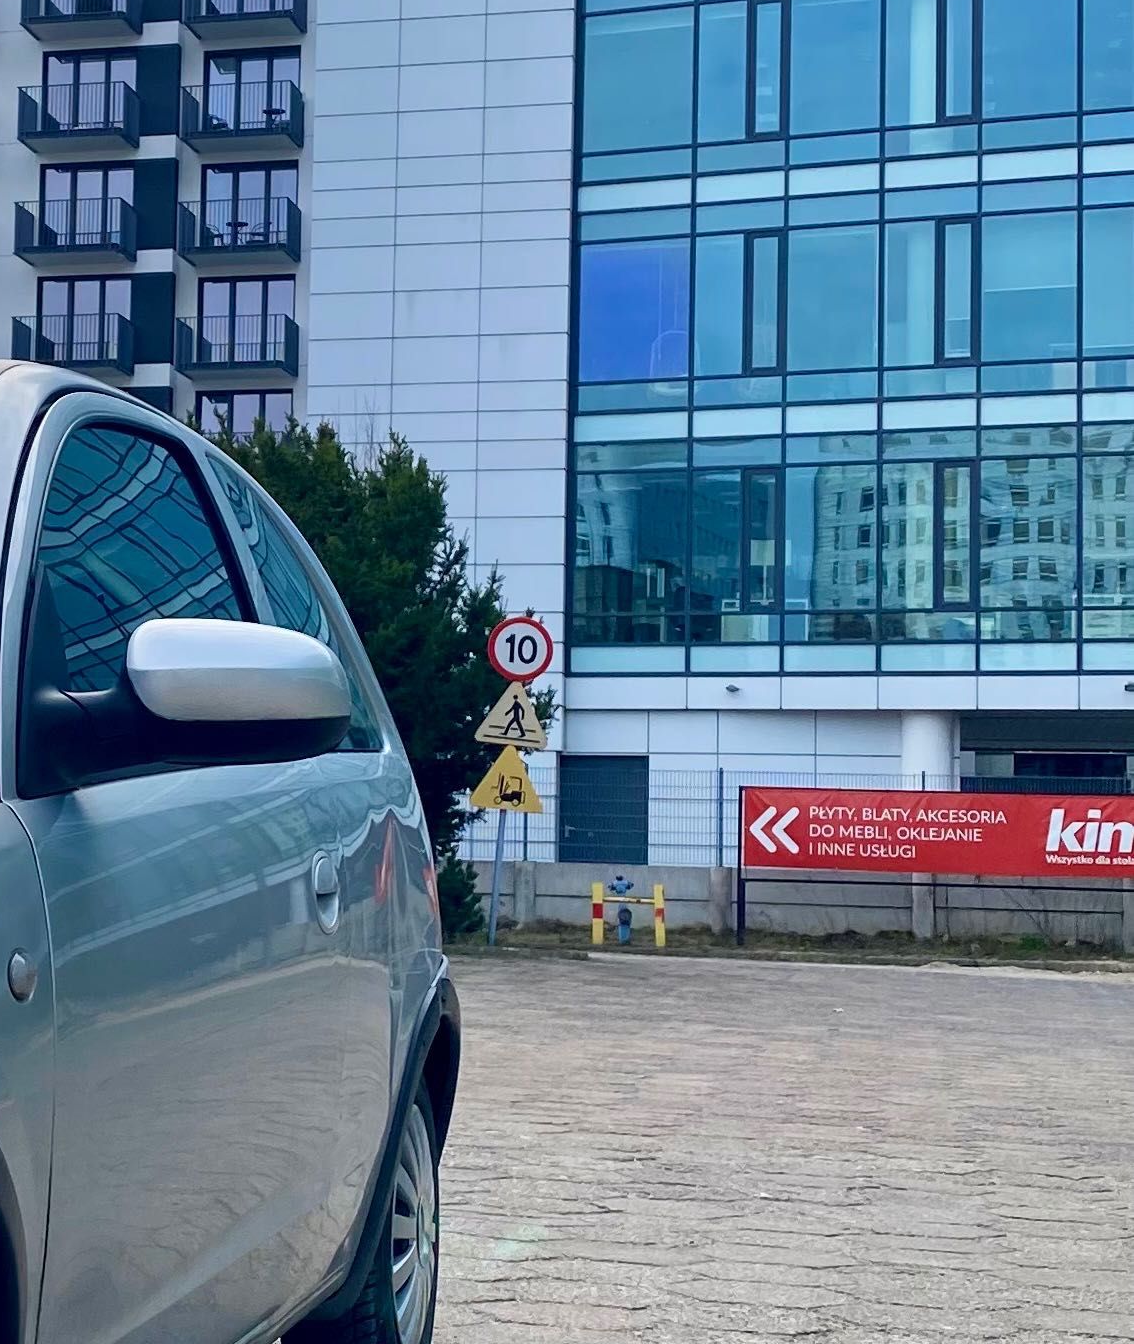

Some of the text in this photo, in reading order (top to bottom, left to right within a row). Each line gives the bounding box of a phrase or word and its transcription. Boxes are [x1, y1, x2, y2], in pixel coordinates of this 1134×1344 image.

[506, 633, 538, 665] 10
[809, 806, 1007, 825] PŁYTY, BLATY, AKCESORIA
[809, 824, 983, 842] DO MEBLI, OKLEJANIE
[809, 843, 916, 859] I INNE USŁUGI
[1045, 854, 1093, 866] Wszystko
[1095, 855, 1111, 865] dla
